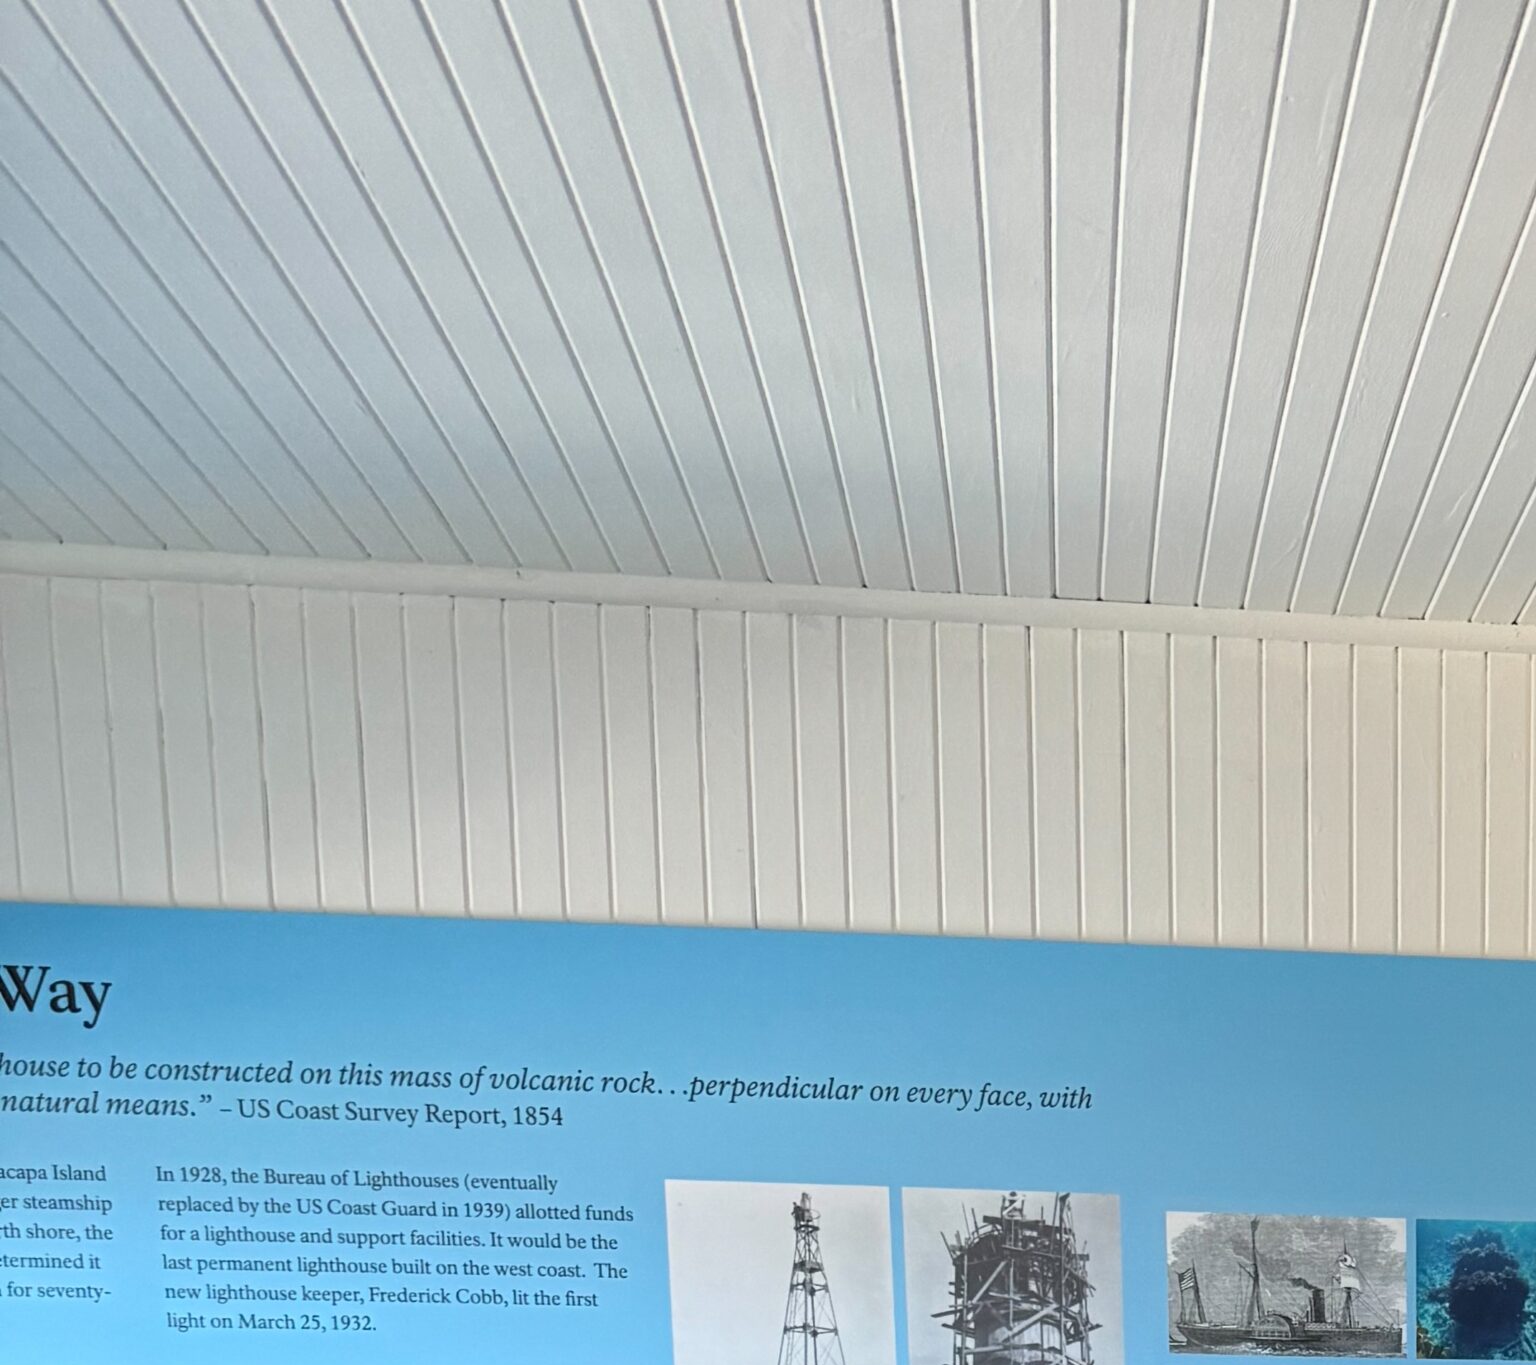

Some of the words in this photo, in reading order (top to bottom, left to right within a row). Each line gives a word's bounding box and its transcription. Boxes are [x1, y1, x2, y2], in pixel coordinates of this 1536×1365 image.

[0, 964, 112, 1029] Way
[76, 1058, 102, 1080] to
[108, 1055, 137, 1080] be
[143, 1057, 294, 1087] constructed
[298, 1067, 332, 1086] on
[335, 1062, 383, 1088] this
[386, 1070, 452, 1089] mass
[458, 1066, 489, 1099] of
[488, 1066, 595, 1093] volcanic
[867, 1085, 900, 1103] on
[905, 1085, 973, 1112] every
[970, 1081, 1033, 1113] face,
[1037, 1084, 1095, 1110] with
[0, 1088, 99, 1113] natural
[236, 1098, 270, 1118] US
[276, 1099, 340, 1120] Coast
[344, 1101, 419, 1128] Survey
[423, 1103, 506, 1130] Report,
[513, 1105, 563, 1126] 1854
[155, 1165, 175, 1182] In
[180, 1165, 227, 1186] 1928,
[230, 1166, 259, 1184] the
[263, 1168, 326, 1185] Bureau
[330, 1168, 350, 1186] of
[352, 1170, 459, 1192] Lighthouses
[463, 1173, 558, 1195] (eventually
[158, 1194, 234, 1217] replaced
[237, 1196, 259, 1218] by
[263, 1196, 291, 1214] the
[295, 1198, 323, 1214] US
[326, 1198, 377, 1215] Coast
[381, 1199, 437, 1217] Guard
[441, 1201, 459, 1217] in
[463, 1201, 510, 1221] 1939)
[515, 1202, 581, 1220] allotted
[584, 1204, 633, 1221] funds
[159, 1223, 186, 1240] for
[189, 1229, 200, 1241] a
[203, 1224, 295, 1247] lighthouse
[299, 1226, 333, 1244] and
[337, 1230, 406, 1250] support
[409, 1229, 486, 1246] facilities.
[489, 1231, 503, 1247] It
[506, 1231, 561, 1248] would
[565, 1232, 587, 1249] be
[590, 1233, 618, 1250] the
[161, 1253, 192, 1270] last
[196, 1257, 293, 1276] permanent
[296, 1256, 387, 1278] lighthouse
[391, 1258, 431, 1274] built
[435, 1263, 458, 1275] on
[462, 1258, 490, 1276] the
[493, 1262, 533, 1276] west
[537, 1263, 586, 1278] coast.
[592, 1262, 628, 1279] The
[164, 1287, 201, 1299] new
[205, 1283, 297, 1305] lighthouse
[301, 1285, 364, 1306] keeper,
[368, 1286, 451, 1303] Frederick
[455, 1288, 508, 1307] Cobb,
[511, 1288, 530, 1305] lit
[533, 1289, 561, 1306] the
[564, 1289, 599, 1307] first
[166, 1311, 206, 1333] light
[210, 1317, 233, 1328] on
[238, 1312, 296, 1329] March
[300, 1314, 326, 1333] 25,
[331, 1314, 376, 1331] 1932.
